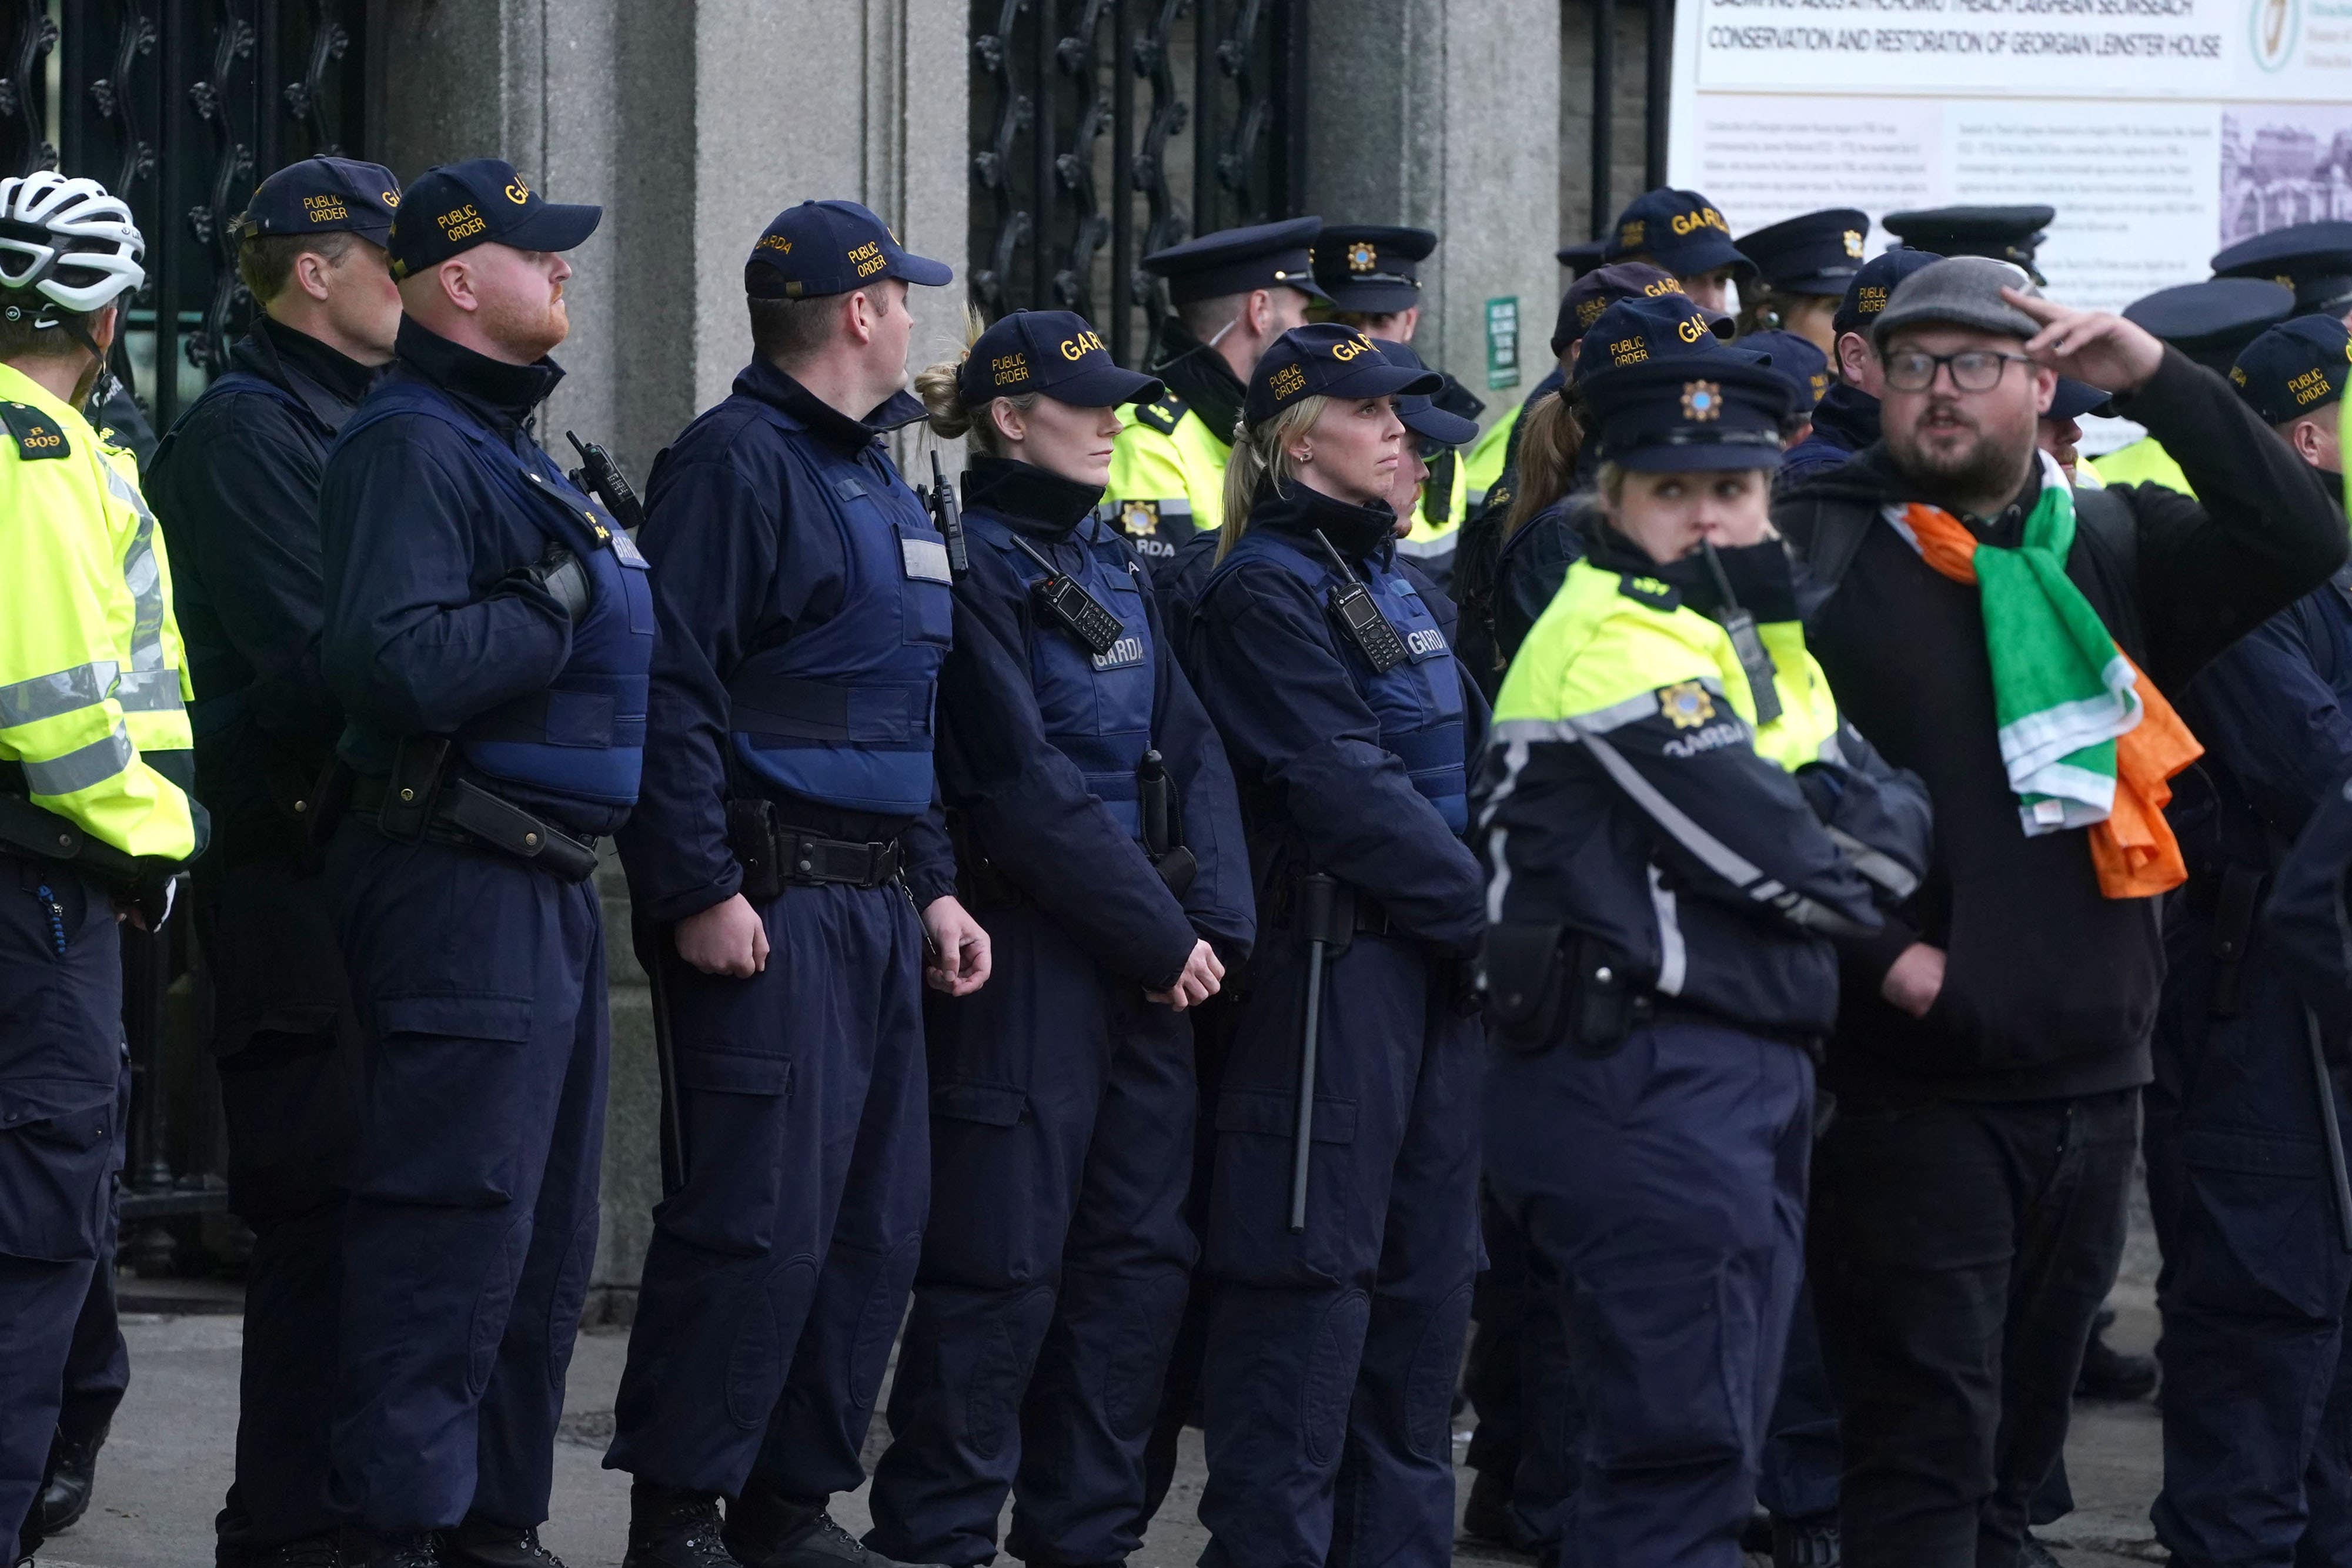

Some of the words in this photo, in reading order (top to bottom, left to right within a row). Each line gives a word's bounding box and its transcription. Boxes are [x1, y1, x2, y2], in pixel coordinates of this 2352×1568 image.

[1708, 25, 1832, 50] CONSERVATION
[1837, 28, 1870, 51] AND
[1876, 28, 1982, 53] RESTORATION
[1986, 30, 2006, 54] OF
[2011, 31, 2092, 56] GEORGIAN
[2095, 32, 2165, 57] LEINSTER
[2169, 34, 2221, 58] HOUSE
[303, 195, 343, 209] PUBLIC
[310, 207, 348, 223] ORDER
[437, 204, 477, 229] PUBLIC
[447, 217, 486, 242] ORDER
[848, 241, 879, 264] PUBLIC
[857, 254, 887, 278] ORDER
[1859, 287, 1887, 299] PUBLIC
[1858, 299, 1886, 313] ORDER
[1611, 336, 1645, 356] PUBLIC
[992, 353, 1026, 371] PUBLIC
[1615, 349, 1649, 368] ORDER
[994, 367, 1030, 386] ORDER
[1269, 363, 1302, 388] PUBLIC
[2287, 367, 2323, 393] PUBLIC
[1275, 375, 1307, 401] ORDER
[2297, 380, 2331, 405] ORDER
[31, 426, 44, 436] B
[24, 435, 59, 448] 309
[1135, 539, 1175, 557] RDA
